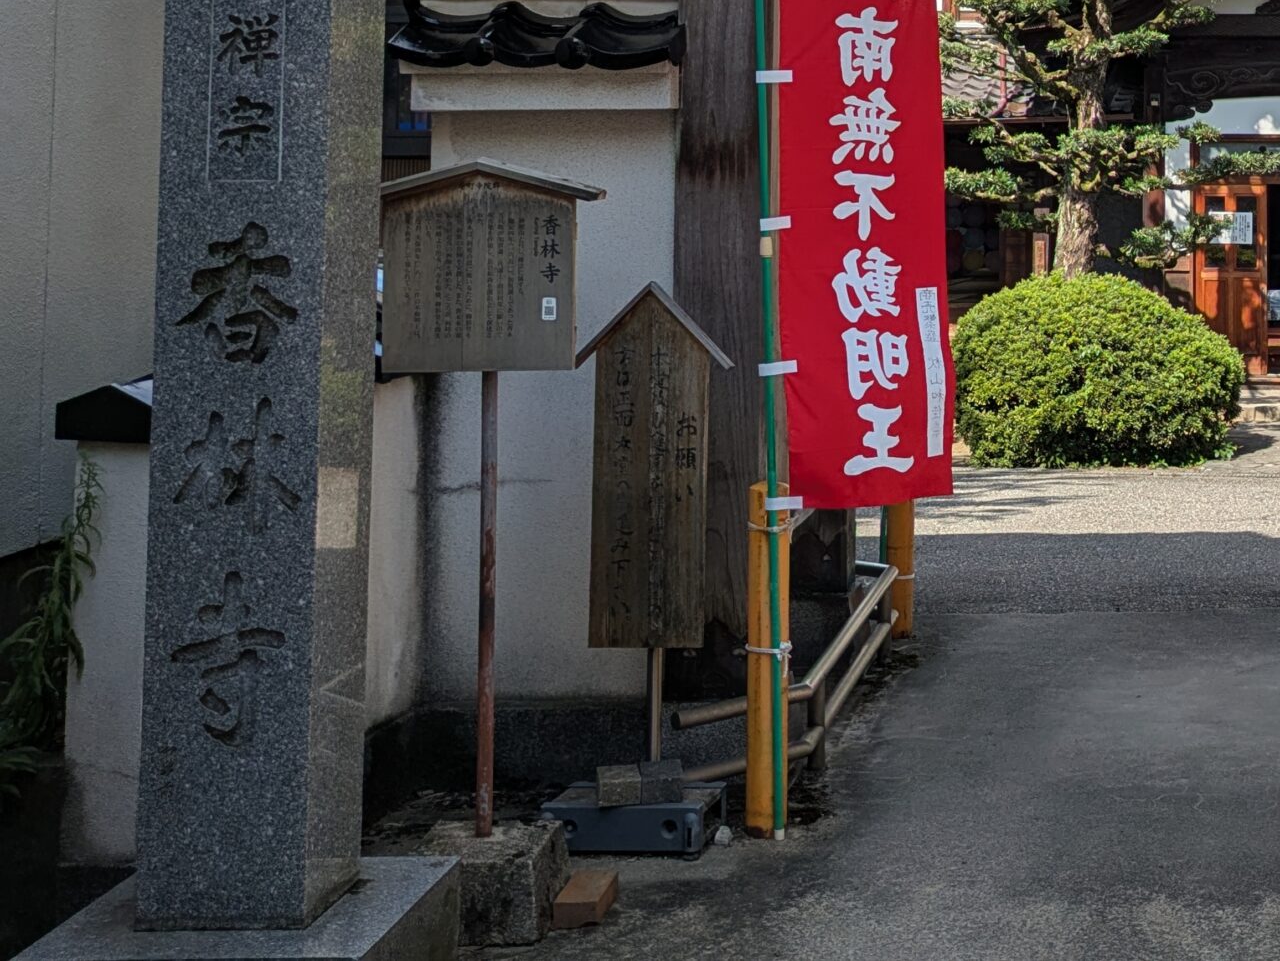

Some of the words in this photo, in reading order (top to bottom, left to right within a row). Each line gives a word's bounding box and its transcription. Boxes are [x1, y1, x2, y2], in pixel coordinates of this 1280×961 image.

[539, 214, 561, 284] 香林寺
[169, 221, 302, 748] 香林寺
[675, 411, 697, 503] お願い
